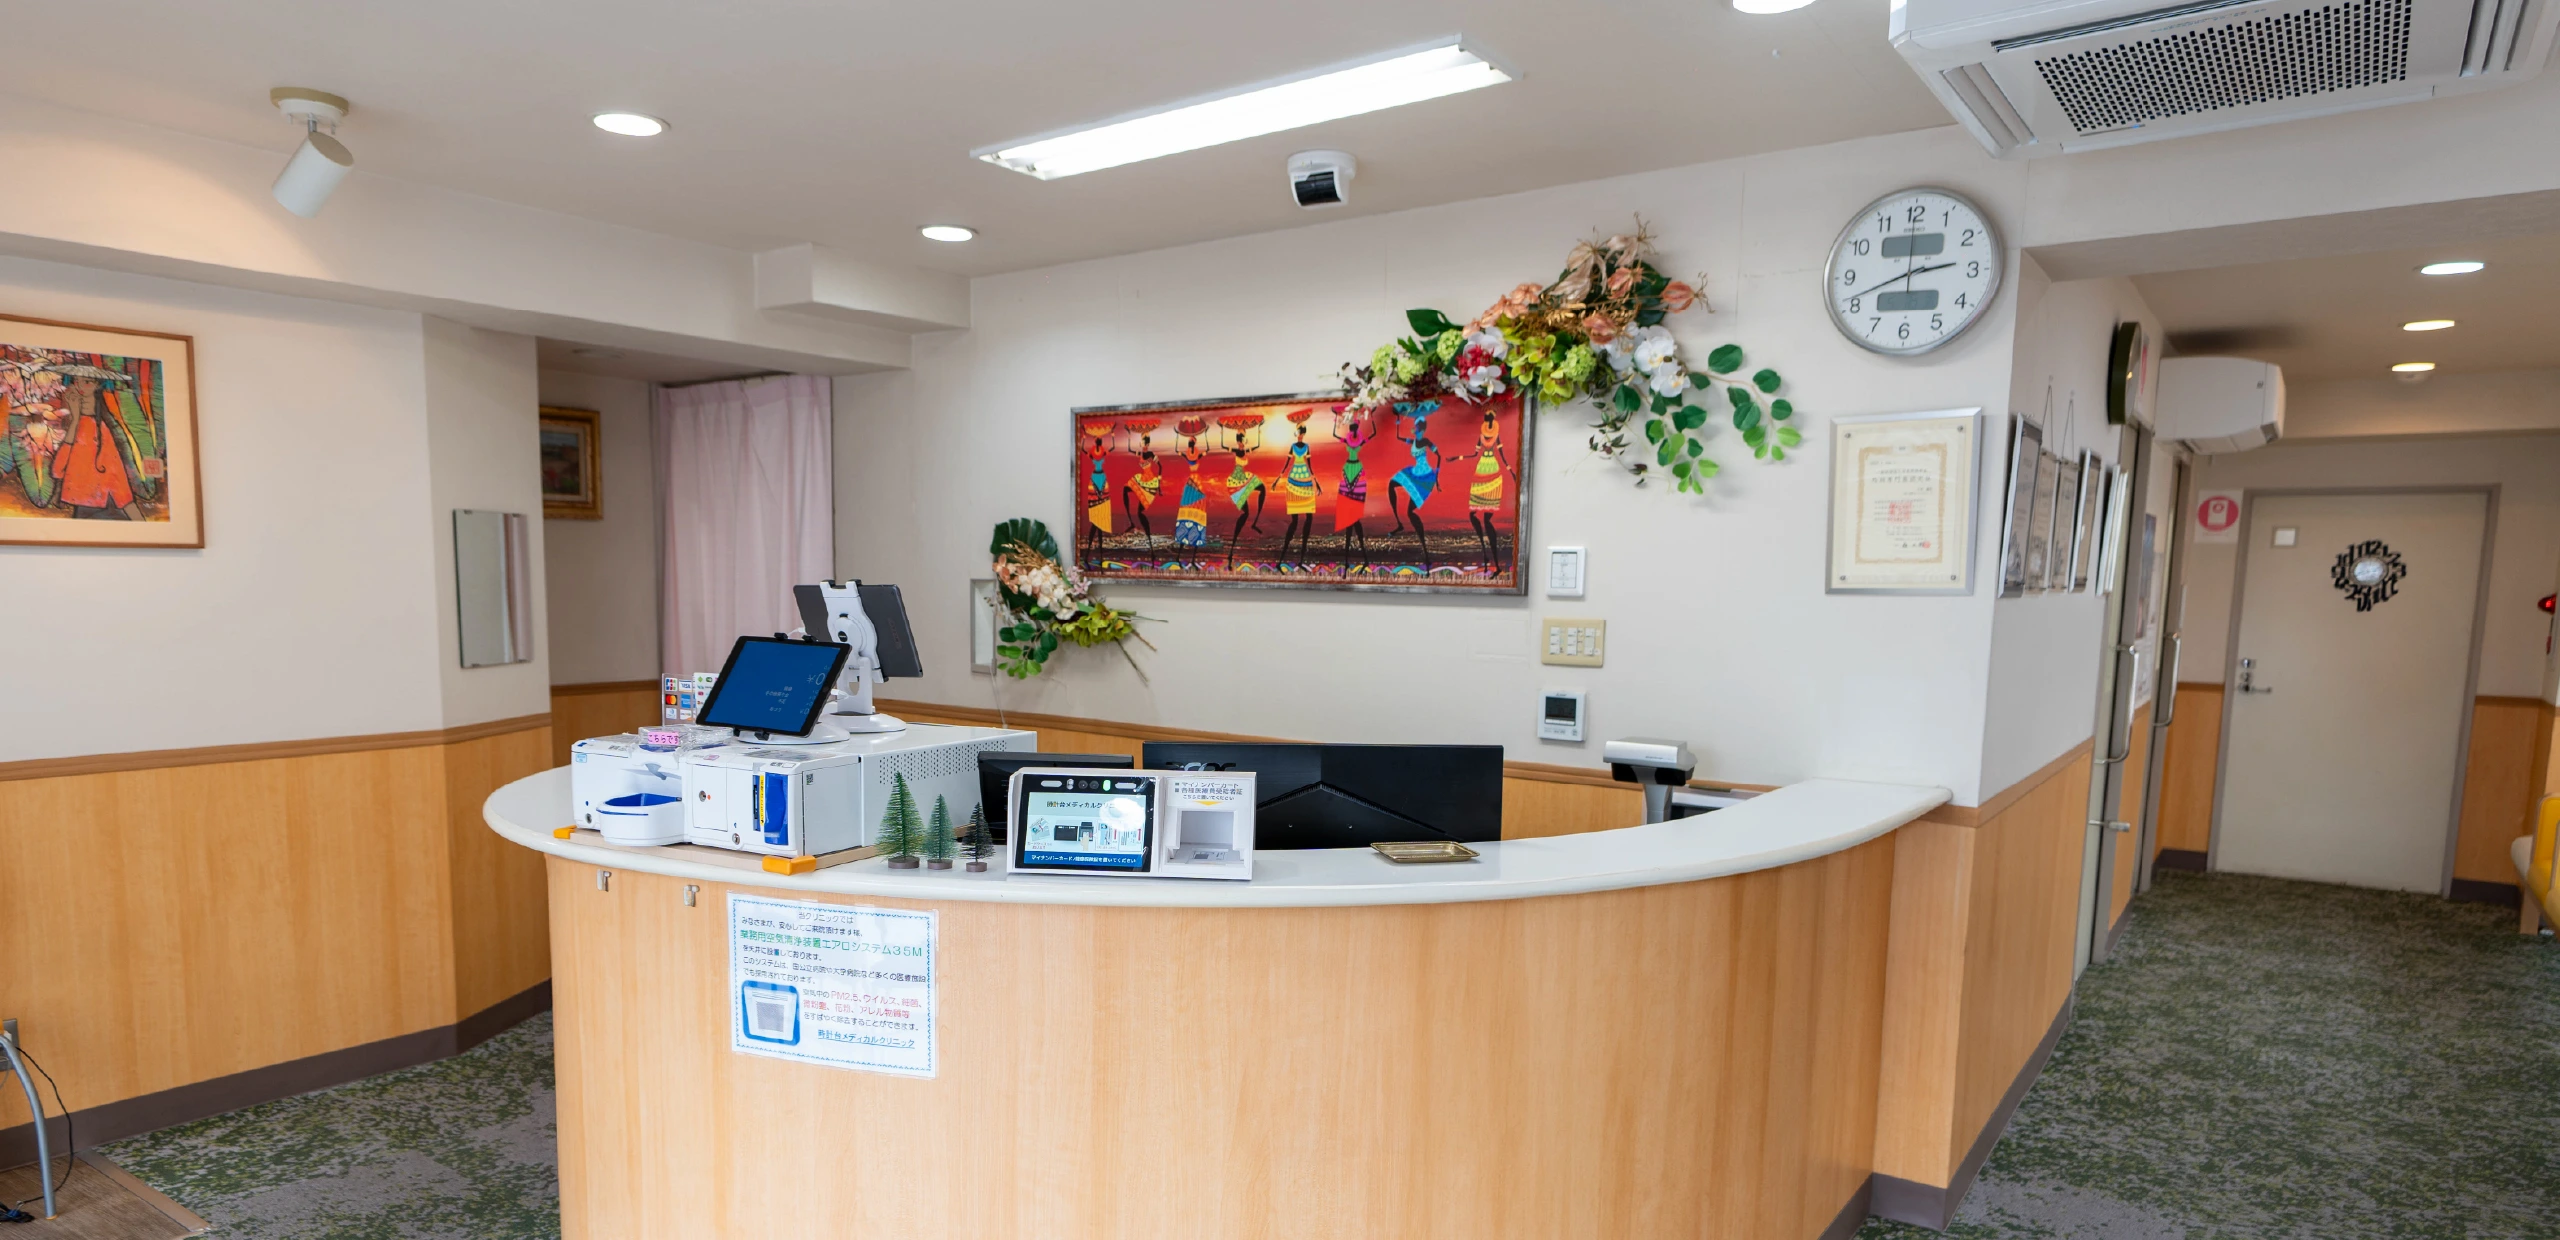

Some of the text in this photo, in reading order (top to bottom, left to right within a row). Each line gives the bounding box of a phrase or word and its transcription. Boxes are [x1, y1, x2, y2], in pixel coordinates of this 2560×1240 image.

[1907, 206, 1926, 223] 12
[1943, 211, 1949, 227] 1
[1878, 216, 1891, 232] 11
[1961, 229, 1974, 247] 2
[1852, 239, 1870, 256] 10
[1844, 269, 1856, 286] 9
[1967, 261, 1979, 278] 3
[1850, 298, 1861, 313] 8
[1954, 292, 1966, 309] 4
[1869, 317, 1881, 333] 7
[1930, 313, 1943, 330] 5
[1898, 323, 1910, 339] 6
[649, 734, 679, 745] こちらです
[1046, 800, 1115, 809] 時計台メディカルクリニ
[798, 911, 854, 924] 当クリニックでは
[817, 1029, 915, 1048] 時計台メディカルクリニック
